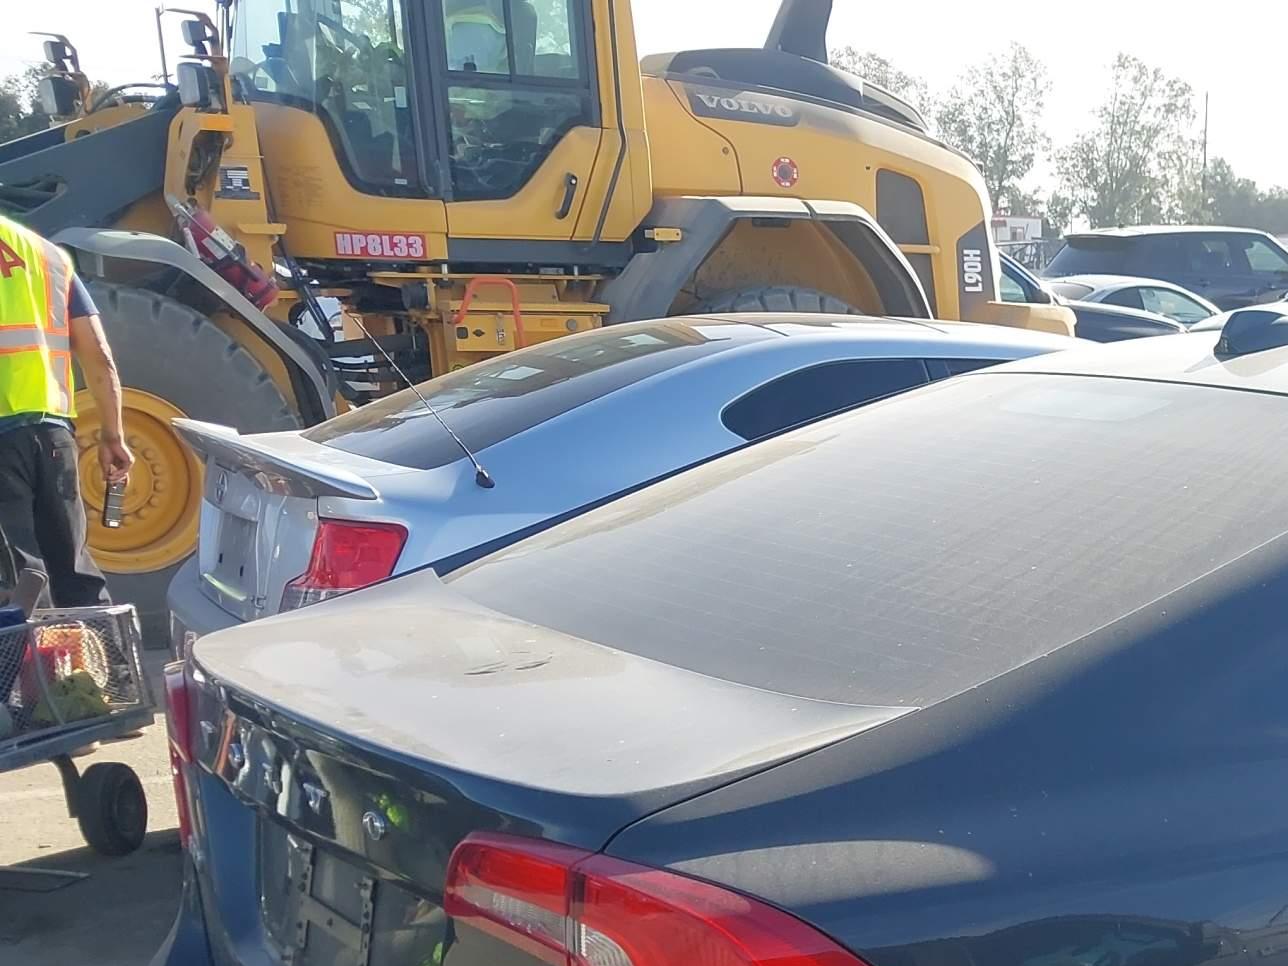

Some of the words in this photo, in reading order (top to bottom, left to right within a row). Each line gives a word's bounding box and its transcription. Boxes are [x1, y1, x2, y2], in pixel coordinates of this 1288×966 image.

[696, 93, 793, 118] VOLVO
[335, 233, 424, 257] HP8L33
[963, 249, 983, 292] L90H
